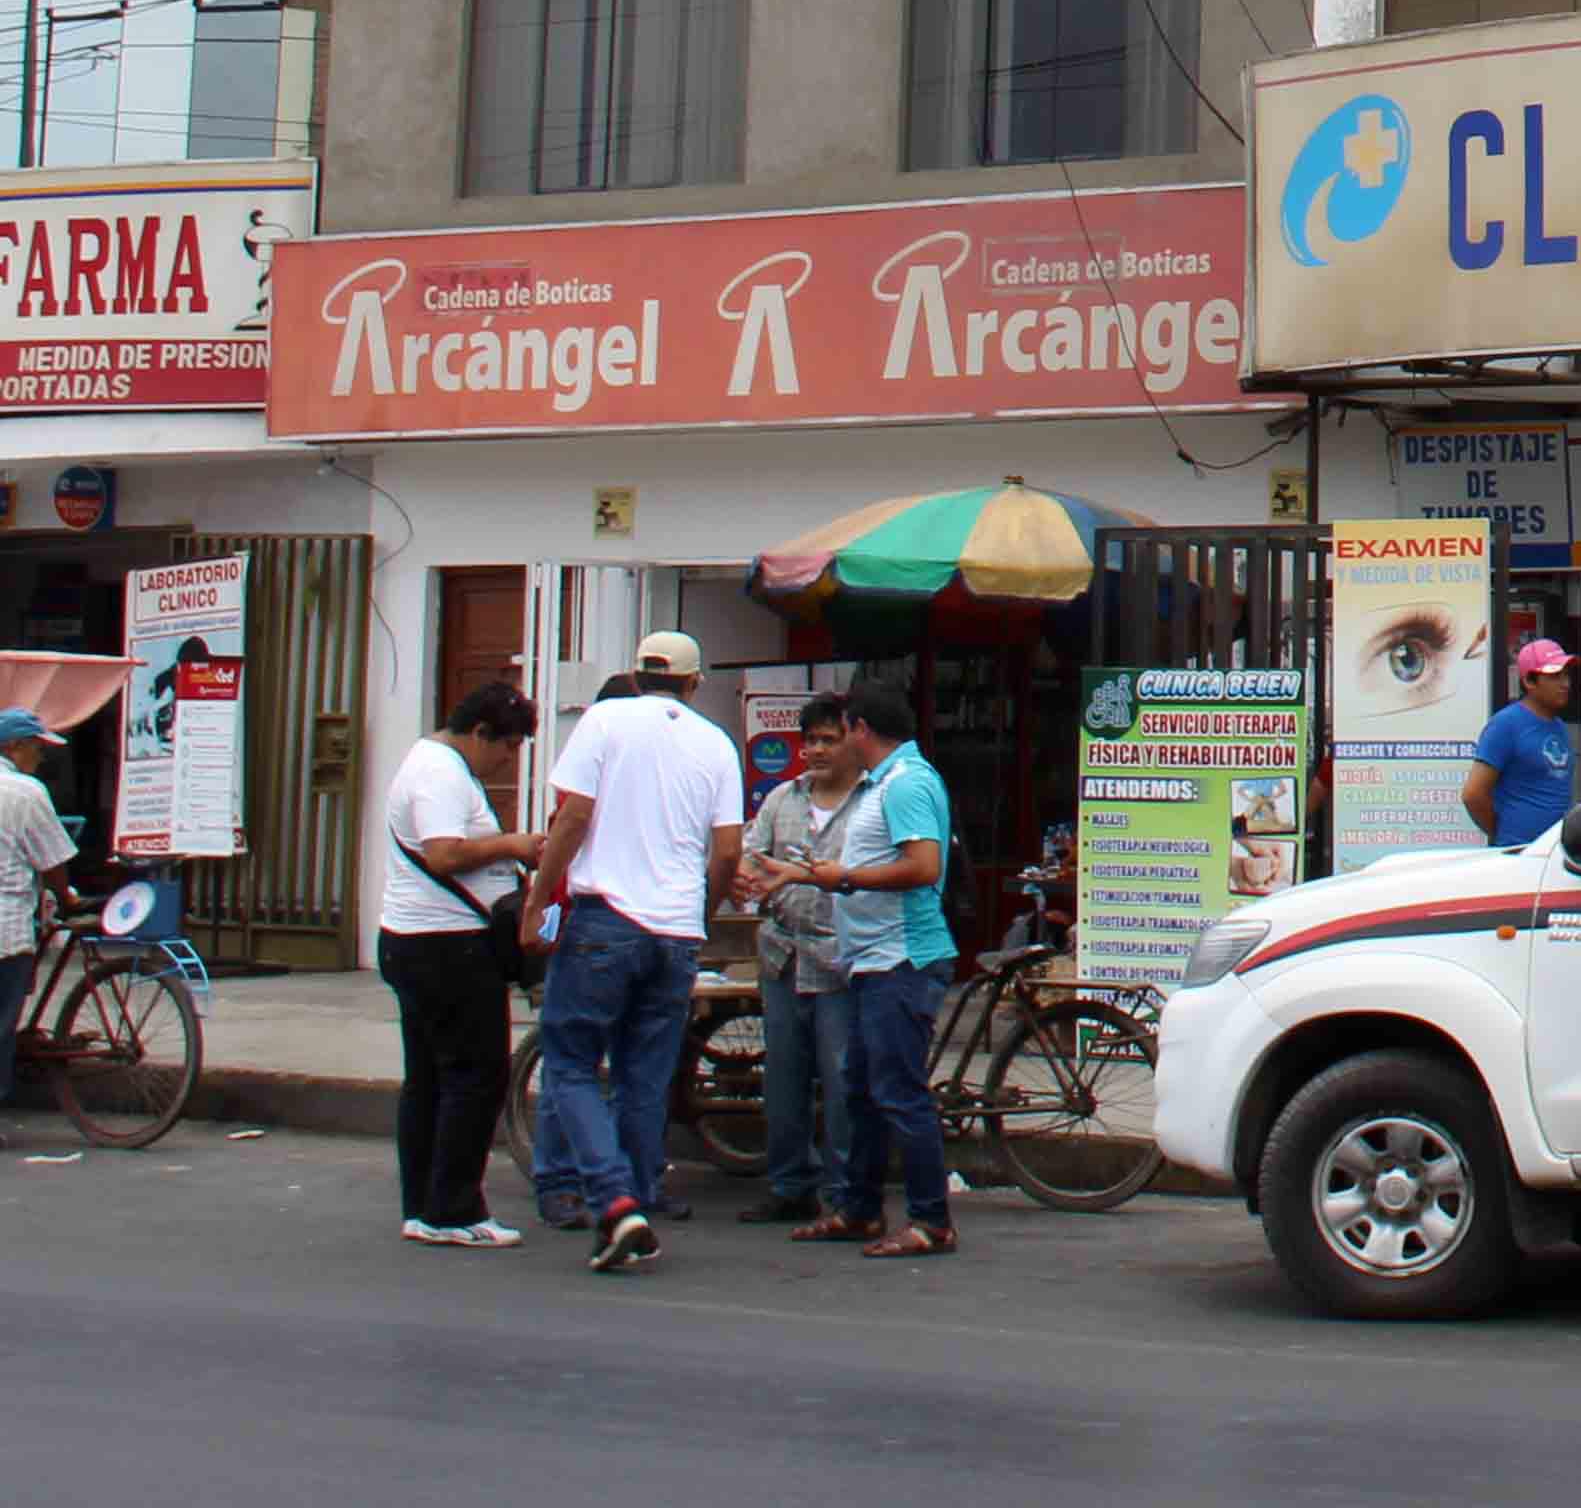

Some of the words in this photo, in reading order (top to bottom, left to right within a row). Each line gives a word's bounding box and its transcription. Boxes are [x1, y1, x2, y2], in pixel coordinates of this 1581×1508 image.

[991, 258, 1081, 287] Cadena
[1086, 256, 1118, 281] de
[1121, 248, 1211, 278] Boticas
[424, 285, 500, 312] Cadena
[503, 284, 531, 308] de
[534, 279, 612, 305] Boticas
[880, 252, 1248, 392] Arcánge
[18, 345, 112, 372] MEDIDA
[118, 343, 152, 370] DE
[159, 343, 270, 370] PRESION
[328, 277, 660, 412] Arcángel
[0, 374, 133, 401] ORTADAS
[1405, 433, 1556, 465] DESPISTAJE
[1466, 469, 1497, 499] DE
[1337, 536, 1483, 558] EXAMEN
[140, 562, 239, 592] LABORATORIO
[158, 587, 217, 612] CLINICO
[1139, 672, 1222, 699] CLINICA
[1228, 672, 1299, 699] BELEN
[1141, 713, 1209, 734] SERVICIO
[1215, 713, 1233, 734] DE
[1237, 713, 1296, 734] TERAPIA
[1088, 740, 1140, 765] FÍSICA
[1144, 745, 1156, 765] Y
[1158, 740, 1296, 766] REHABILITACIÓN
[1084, 778, 1199, 800] ATENDEMOS:
